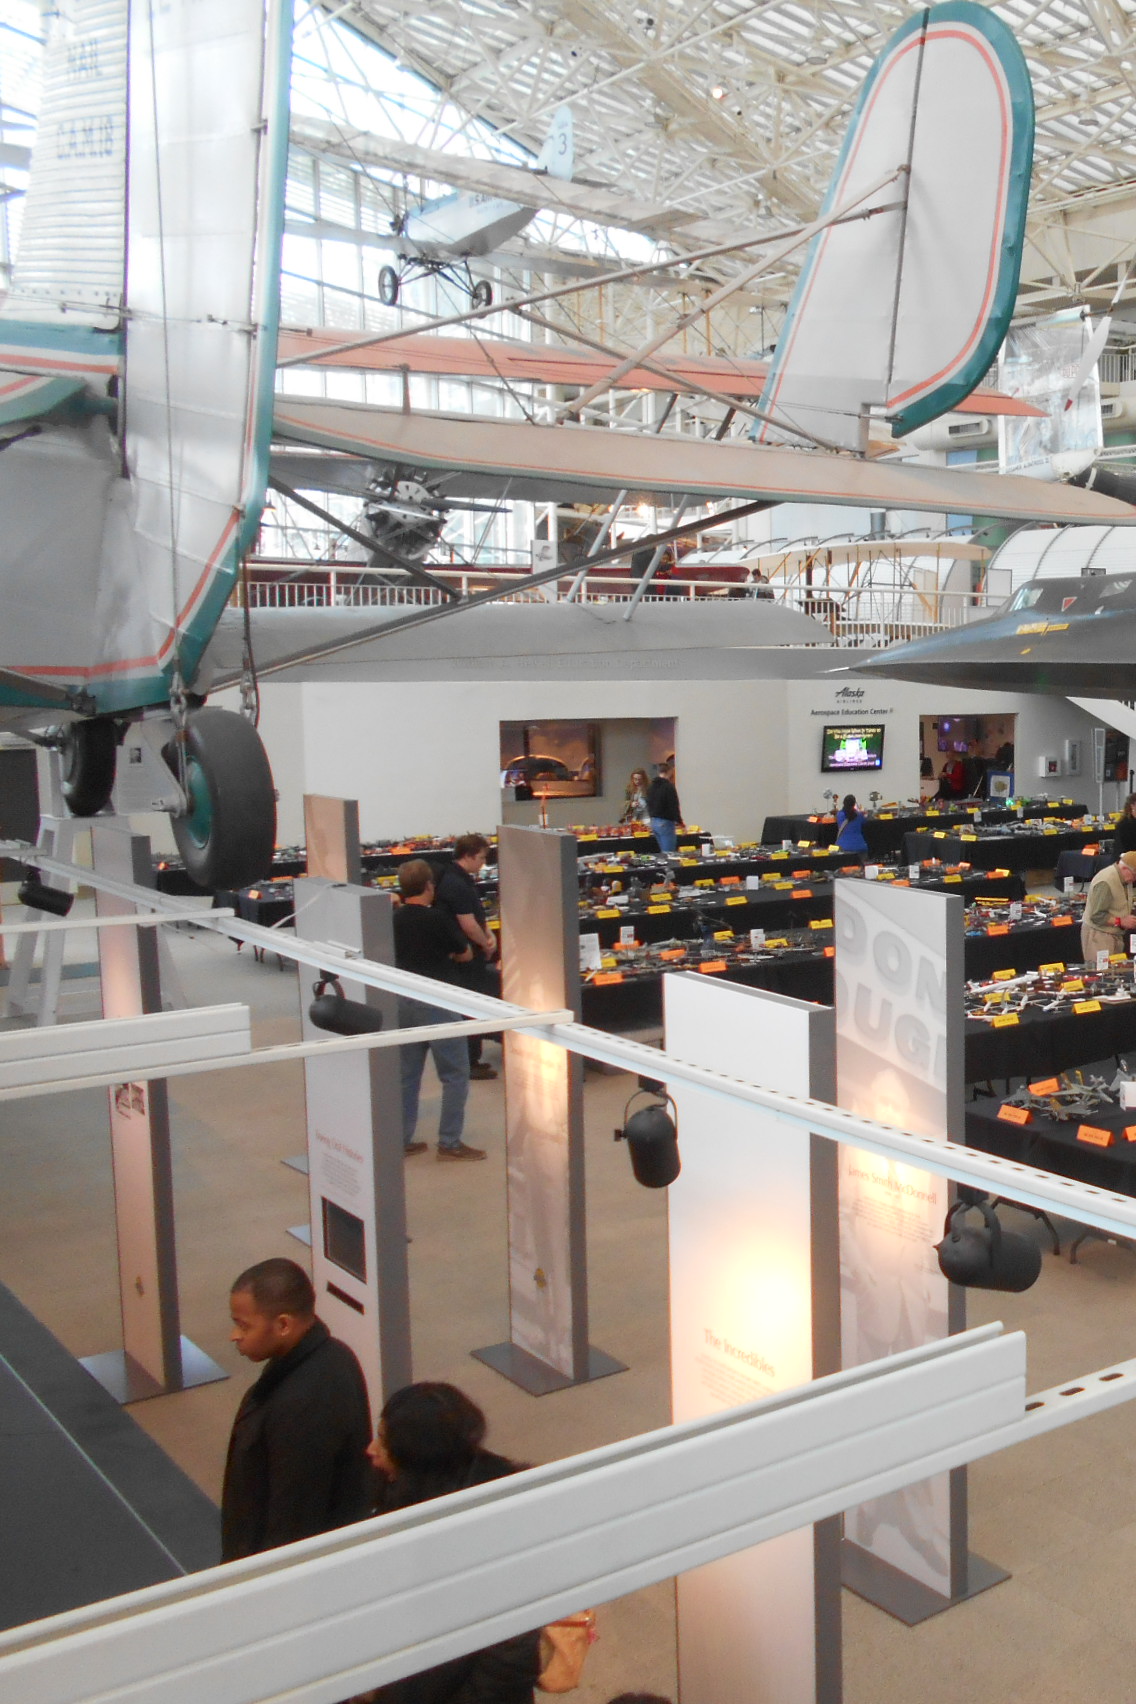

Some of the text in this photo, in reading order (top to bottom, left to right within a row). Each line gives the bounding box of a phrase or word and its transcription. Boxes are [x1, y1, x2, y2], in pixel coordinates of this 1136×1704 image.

[835, 687, 865, 698] Alaska
[811, 706, 888, 717] Aerospace Education Center
[704, 1327, 721, 1351] The
